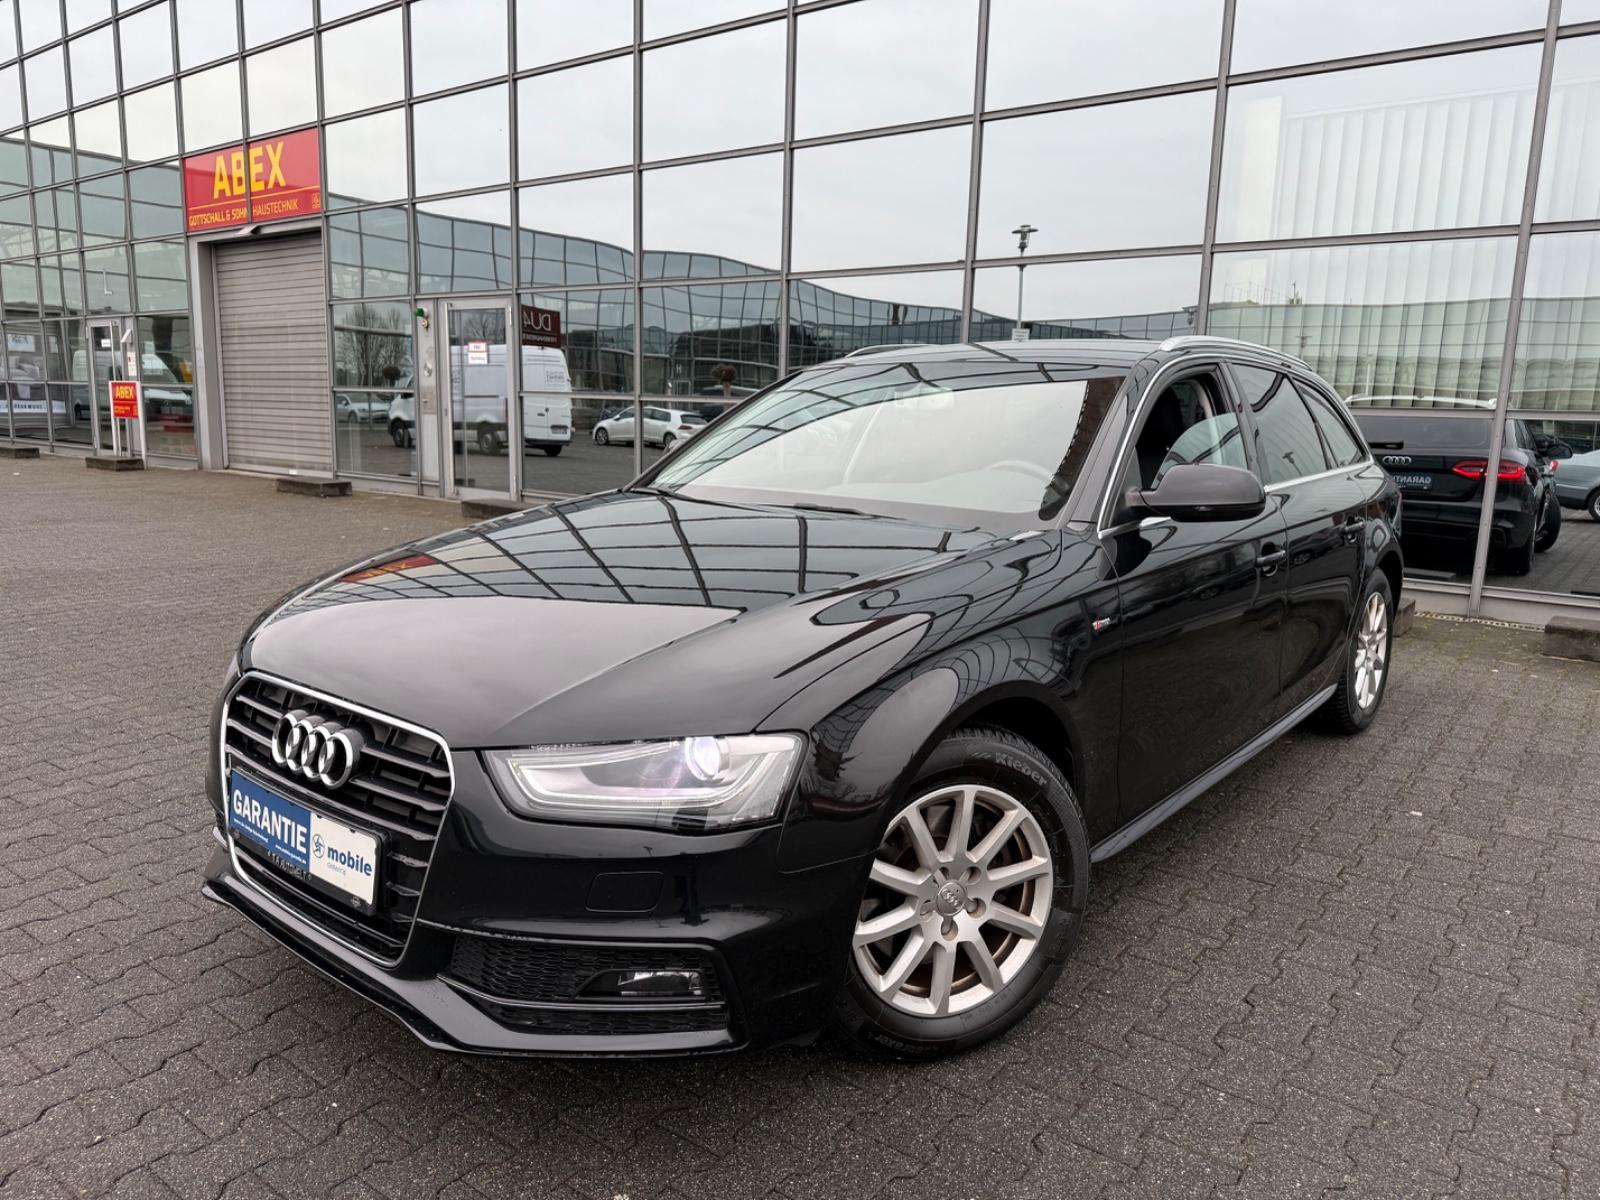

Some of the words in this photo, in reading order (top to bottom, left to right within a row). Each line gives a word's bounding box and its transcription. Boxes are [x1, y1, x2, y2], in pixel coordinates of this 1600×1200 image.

[213, 142, 286, 200] ABEX
[188, 211, 226, 227] GOTTSCHALL
[226, 207, 231, 221] &
[252, 198, 299, 216] HAUSTECHNIK
[115, 385, 135, 400] ABEX
[233, 789, 307, 854] GARANTIE
[327, 846, 372, 876] mobile
